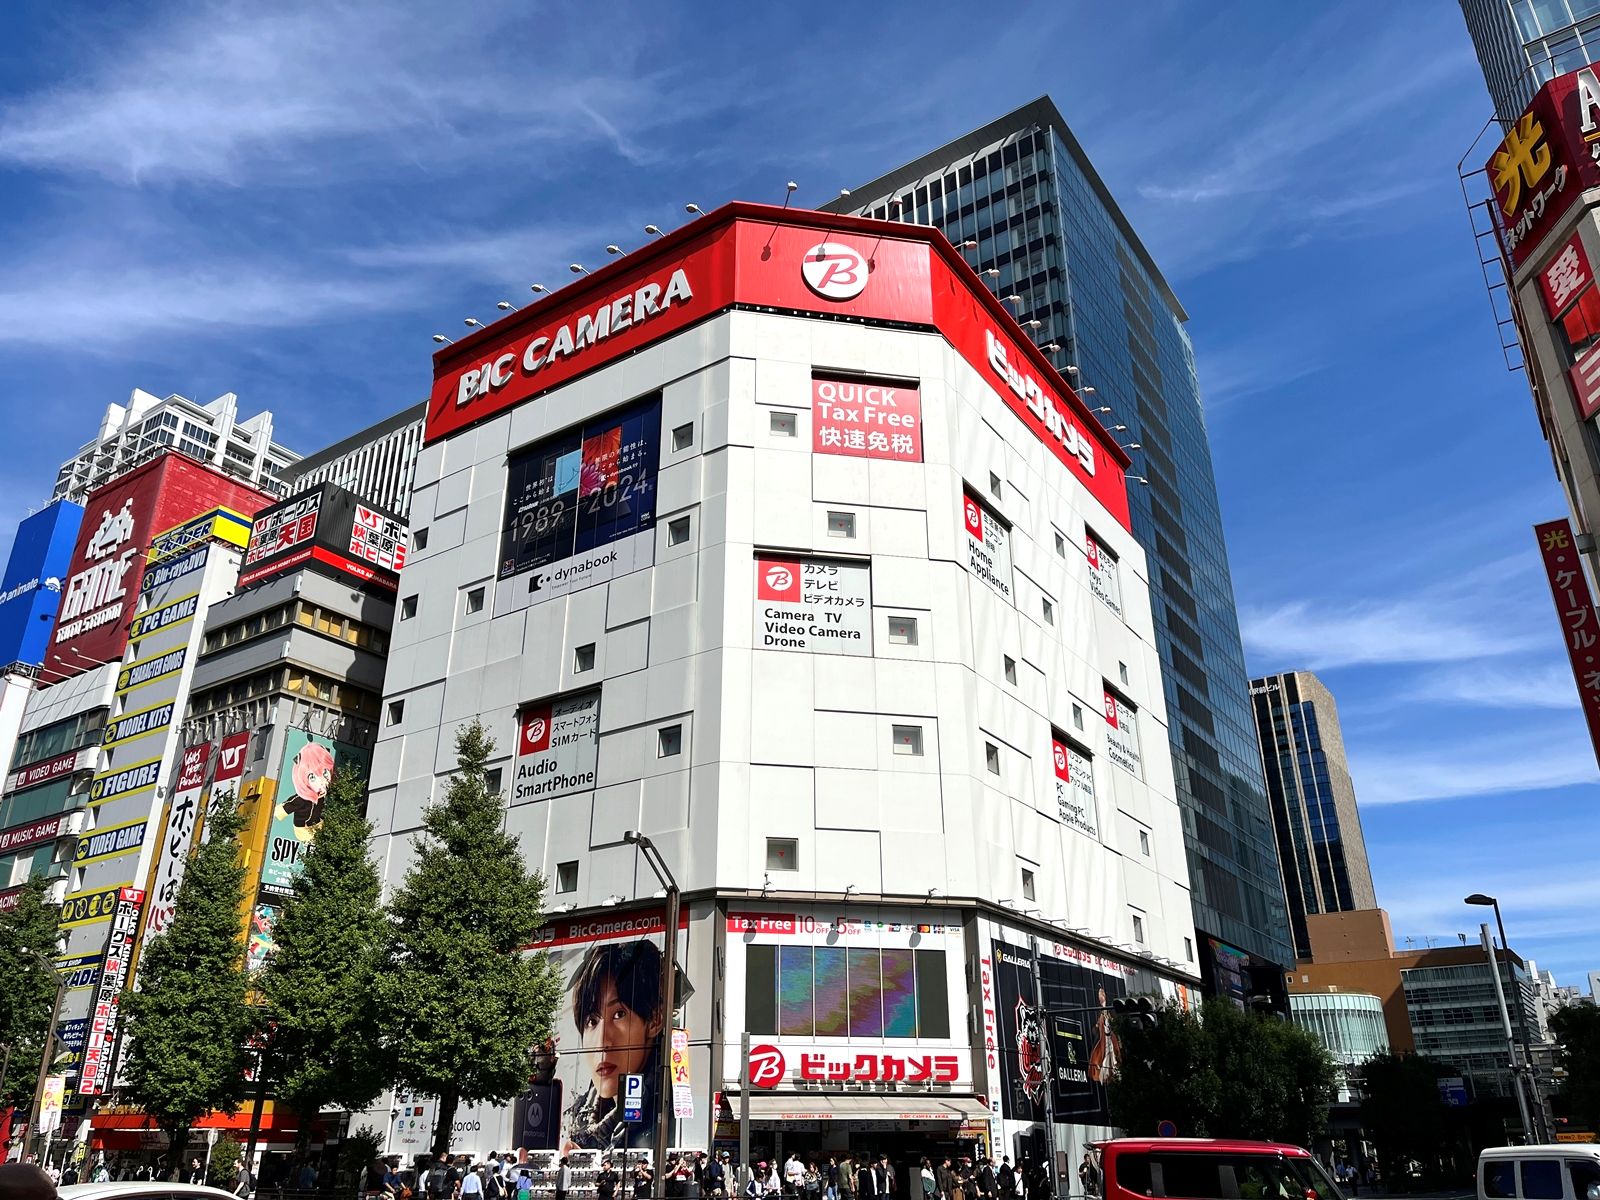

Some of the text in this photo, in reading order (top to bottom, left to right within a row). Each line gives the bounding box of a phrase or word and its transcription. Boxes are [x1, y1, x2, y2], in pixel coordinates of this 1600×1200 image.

[1493, 111, 1551, 217] 光
[1506, 164, 1568, 251] ネットワーク
[456, 268, 693, 406] BIC CAMERA
[818, 382, 897, 407] QUICK
[986, 329, 1095, 477] ビックカメラ
[818, 402, 915, 428] Tax Free
[820, 426, 915, 455] 快速免税
[588, 468, 648, 515] 2024
[271, 494, 320, 527] ボークス
[510, 500, 565, 542] 1989
[157, 521, 213, 556] TRADER
[276, 511, 318, 551] 天国
[353, 524, 393, 552] 秋葉原
[350, 540, 390, 564] ホビー
[968, 538, 993, 569] Home
[153, 549, 207, 586] Blu-ray&DVD
[346, 563, 365, 575] VOLKS
[554, 551, 618, 581] dynabook
[804, 563, 838, 576] カメラ
[970, 555, 1010, 596] Appliance
[1087, 565, 1102, 586] Toys
[6, 578, 38, 601] animate
[59, 548, 136, 623] GAME
[804, 579, 838, 591] テレビ
[803, 593, 865, 608] ビデオカメラ
[142, 597, 196, 634] PC GAME
[764, 608, 842, 624] Camera TV
[764, 634, 806, 648] Drone
[765, 621, 861, 640] Video Camera
[129, 650, 184, 687] CHARACTER GOODS
[554, 700, 593, 717] オーディオ
[117, 705, 171, 739] MODEL KITS
[552, 713, 599, 733] スマートフォン
[551, 728, 597, 748] SIMカード
[29, 757, 75, 781] VIDEO GAME
[517, 759, 557, 780] Audio
[1108, 747, 1135, 773] Cosmetics
[102, 763, 158, 795] FIGURE
[1056, 781, 1064, 795] PC
[1057, 795, 1085, 818] Gaming PC
[1059, 807, 1074, 824] Apple
[11, 821, 58, 844] MUSIC GAME
[89, 824, 145, 856] VIDEO GAME
[271, 837, 300, 864] SPY
[0, 893, 20, 908] ACING
[127, 903, 141, 936] VOLKS
[569, 915, 661, 939] BicCamera.com
[732, 916, 792, 931] Tax Free
[799, 915, 815, 933] 10
[836, 917, 847, 934] 5
[113, 936, 133, 994] AKIHABARA
[1002, 952, 1031, 969] GALLERIA
[980, 956, 997, 1070] Tax Free
[95, 1033, 114, 1086] PARADISE
[800, 1053, 959, 1082] ビックカメラ
[628, 1078, 640, 1095] P
[1058, 1066, 1088, 1084] GALLERIA
[452, 1119, 481, 1132] torola
